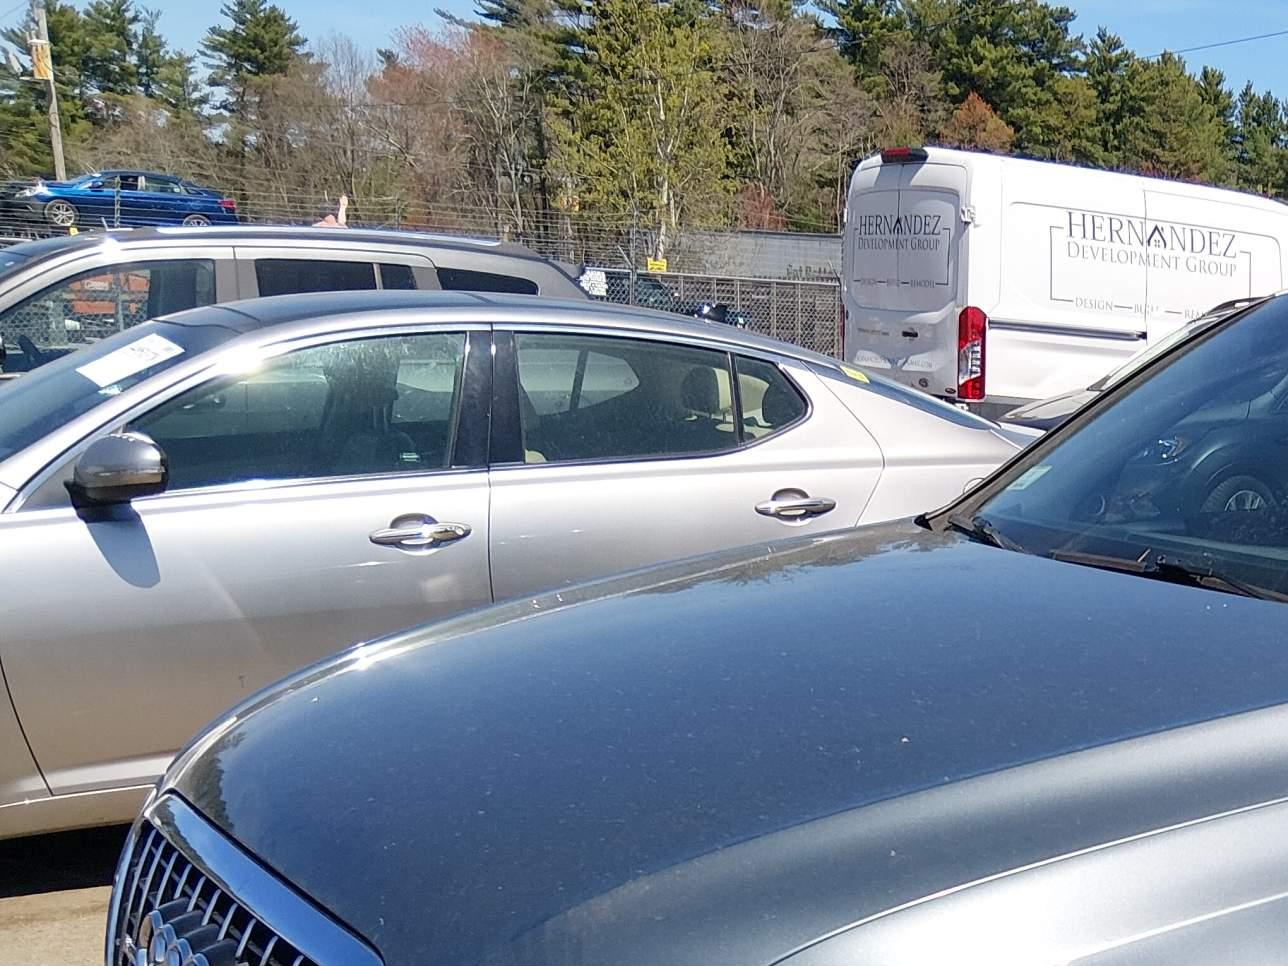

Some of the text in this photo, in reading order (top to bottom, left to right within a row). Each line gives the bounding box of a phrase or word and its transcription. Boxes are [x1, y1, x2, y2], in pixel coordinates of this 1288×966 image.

[859, 215, 942, 236] HERNANDEZ
[1066, 211, 1237, 258] HERNANDEZ
[858, 237, 940, 251] DEVELOPMENT GROUP
[1067, 241, 1237, 278] DEVELOPMENT GROUP
[1075, 297, 1114, 311] DESIGN
